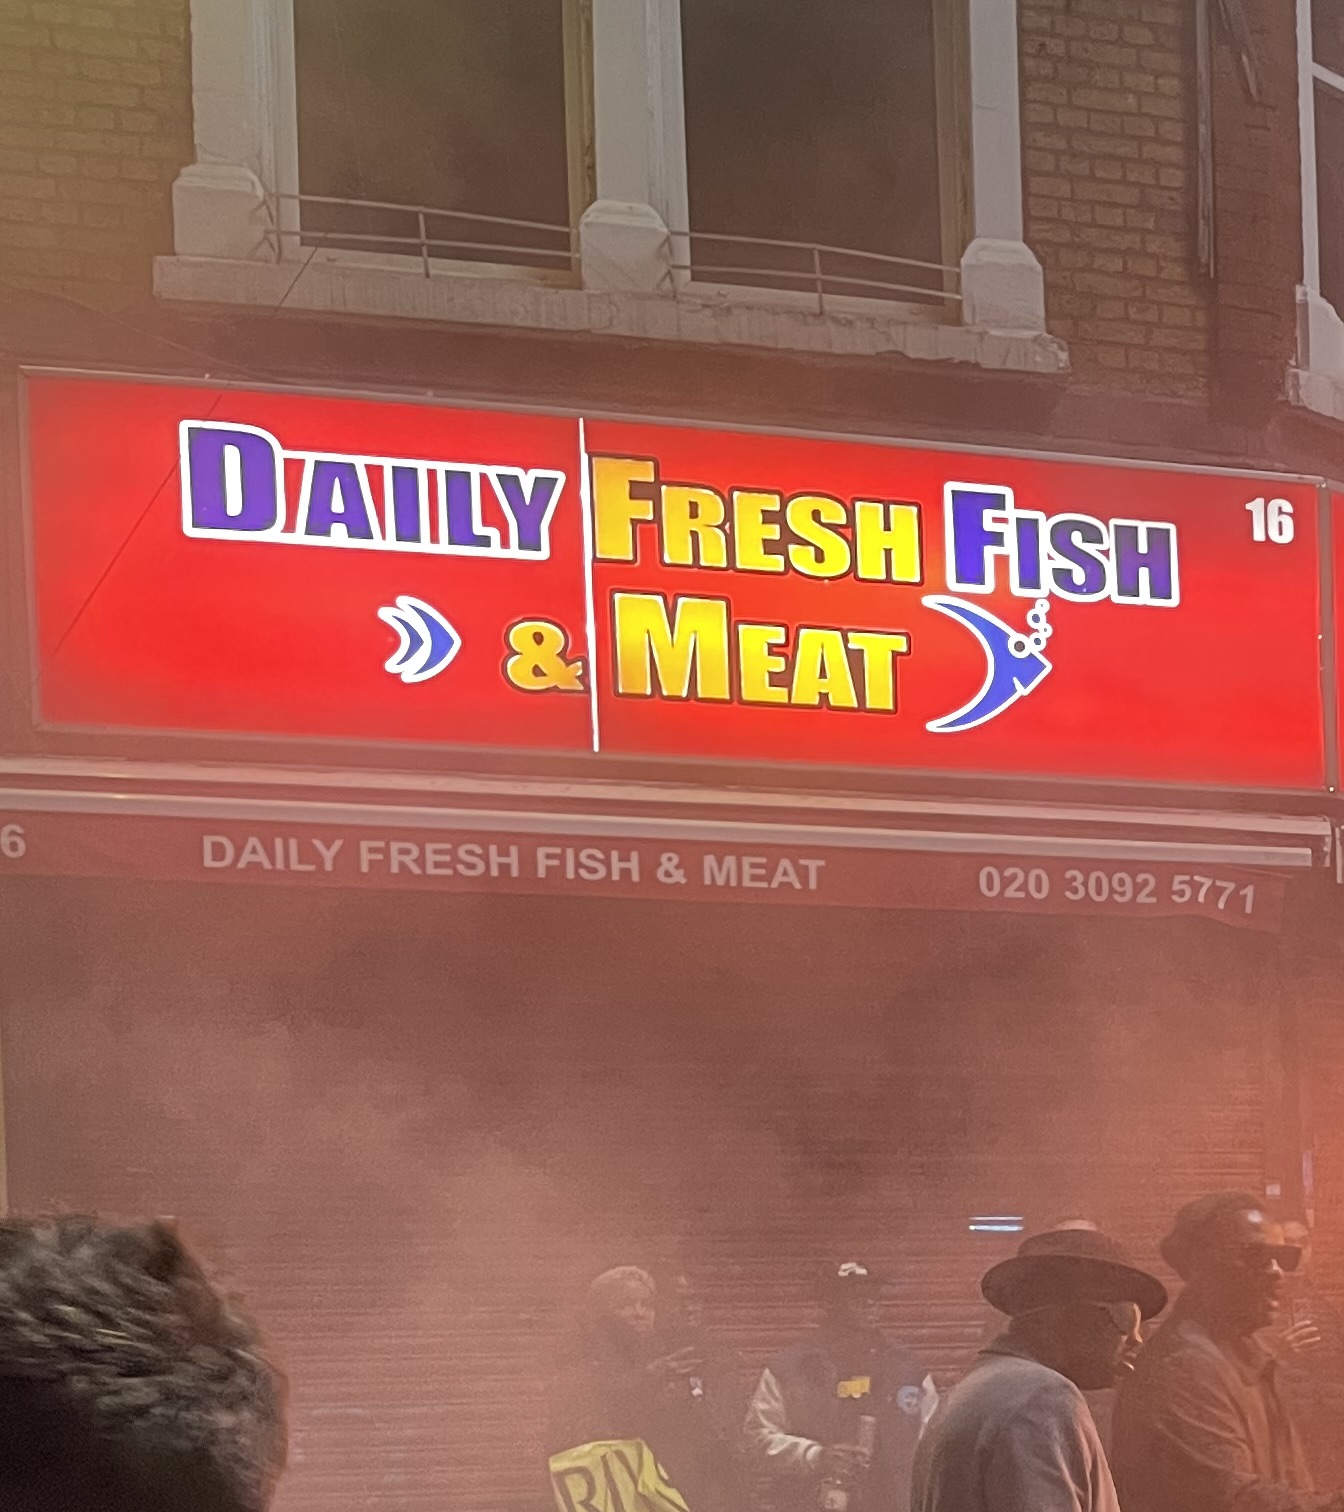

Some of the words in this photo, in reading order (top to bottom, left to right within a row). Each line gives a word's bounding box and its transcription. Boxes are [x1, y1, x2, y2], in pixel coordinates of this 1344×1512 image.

[182, 422, 564, 558] DAILY
[590, 456, 923, 584] FRESH
[943, 482, 1181, 606] FISH
[1245, 497, 1295, 544] 16
[505, 618, 588, 693] &
[611, 591, 911, 713] MEAT
[202, 835, 343, 871] DAILY
[359, 840, 520, 878] FRESH
[537, 846, 640, 882] FISH
[656, 852, 687, 885] &
[703, 855, 826, 890] MEAT
[979, 866, 1050, 899] 020
[1064, 869, 1157, 903] 3092
[1170, 874, 1255, 914] 5771
